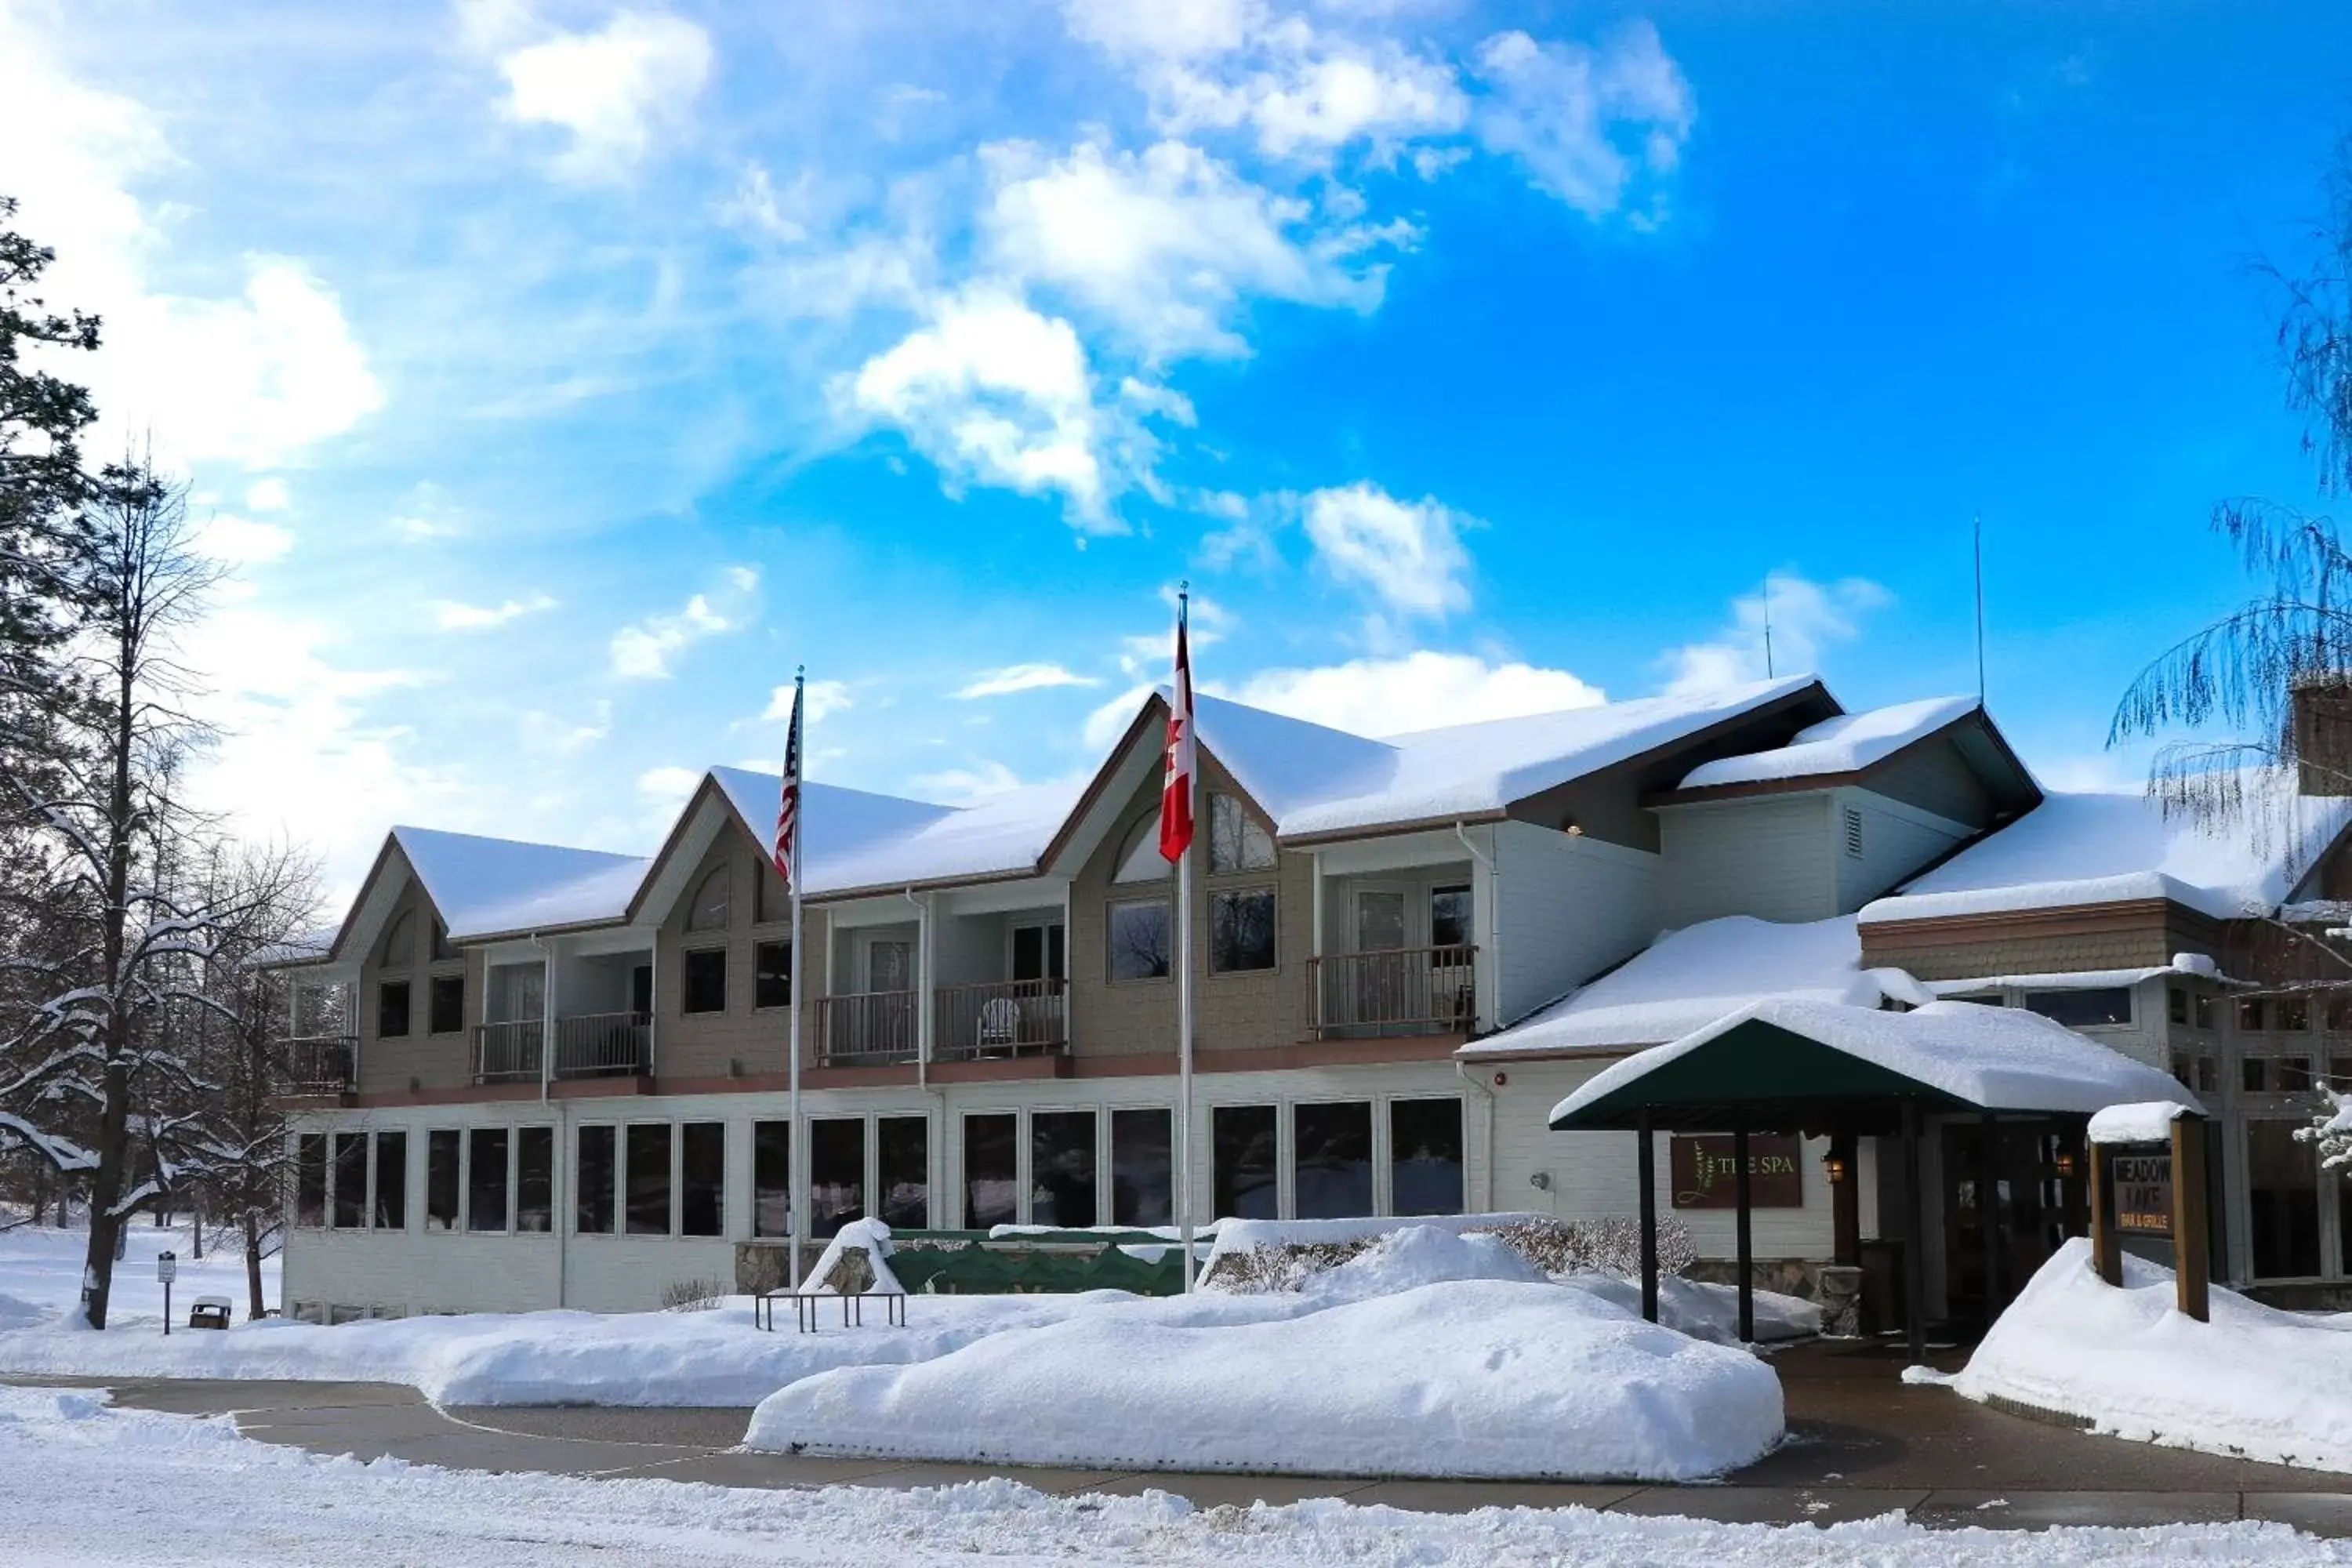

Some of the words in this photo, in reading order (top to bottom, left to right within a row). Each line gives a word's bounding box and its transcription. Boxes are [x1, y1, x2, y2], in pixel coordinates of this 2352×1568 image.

[1761, 1156, 1795, 1174] SPA
[2116, 1158, 2171, 1182] MEADOW
[2125, 1186, 2161, 1210] LAKE
